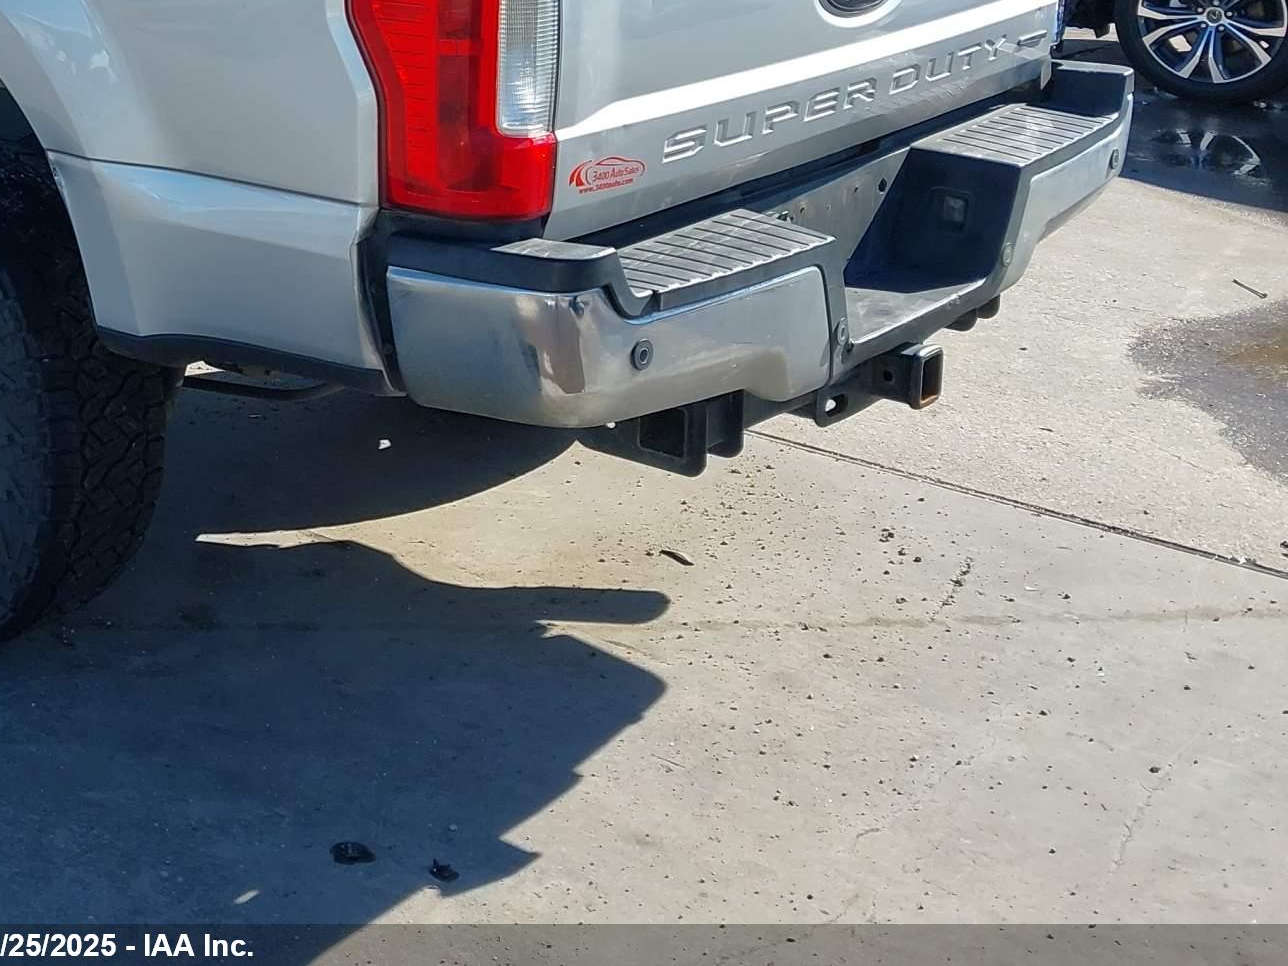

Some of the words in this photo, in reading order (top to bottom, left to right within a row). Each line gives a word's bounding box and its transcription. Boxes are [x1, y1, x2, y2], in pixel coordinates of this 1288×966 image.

[661, 76, 878, 164] SUPER
[888, 33, 1008, 96] DUTY
[592, 169, 610, 182] 3400
[610, 167, 624, 179] Auto
[624, 166, 640, 176] Sales
